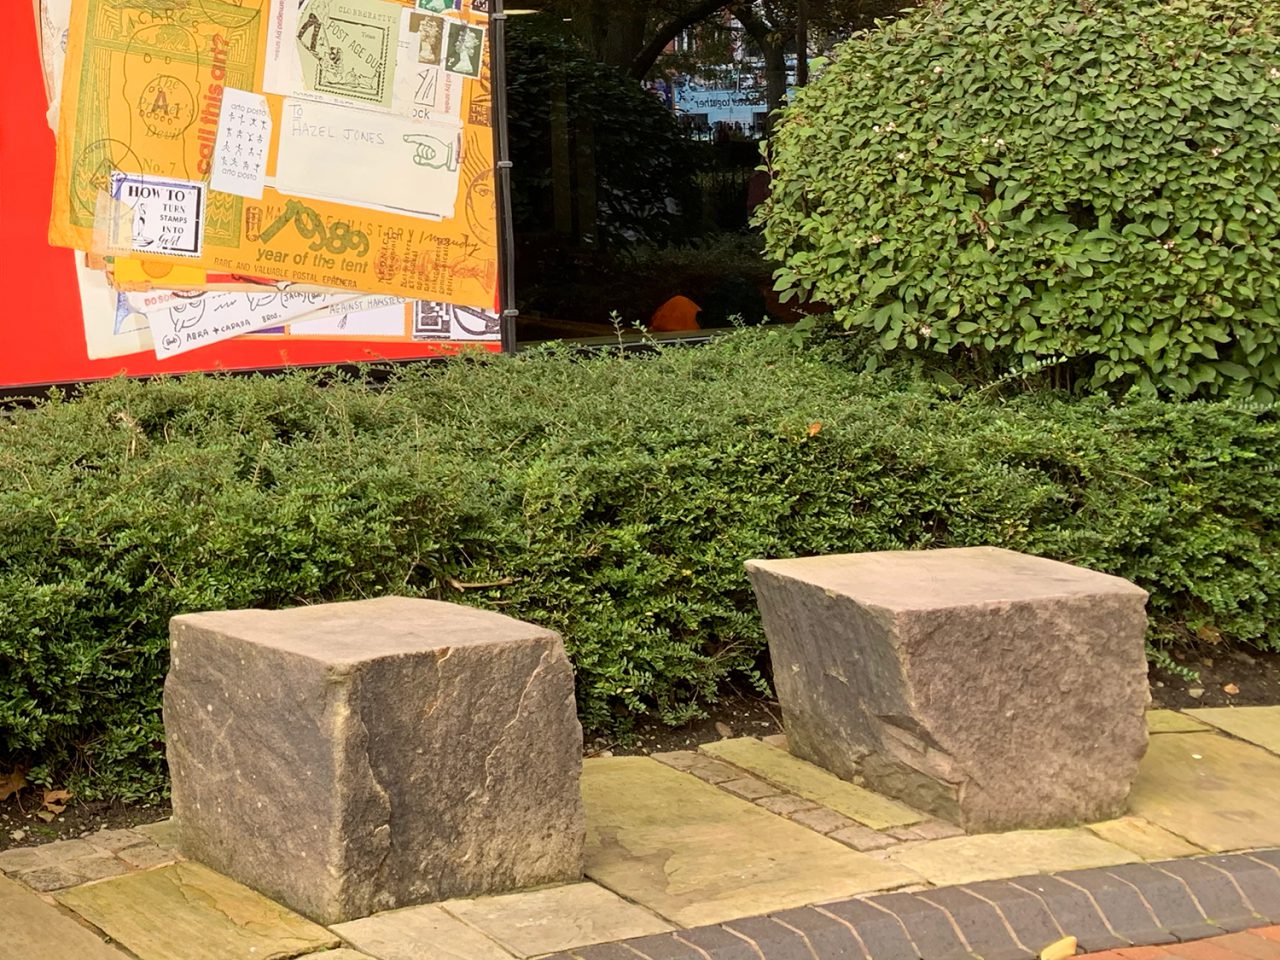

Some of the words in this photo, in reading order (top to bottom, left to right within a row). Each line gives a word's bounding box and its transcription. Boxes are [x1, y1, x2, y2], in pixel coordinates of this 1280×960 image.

[327, 20, 350, 43] POST
[349, 40, 367, 59] AGE
[200, 84, 224, 126] this
[292, 123, 335, 138] HAZEL
[343, 127, 386, 145] JONES
[196, 128, 217, 175] call
[143, 158, 165, 174] No.
[170, 162, 177, 174] 7
[128, 185, 160, 200] HOW
[166, 189, 185, 202] TO
[162, 203, 185, 214] TURN
[160, 214, 188, 224] STAMPS
[260, 198, 370, 258] 1989
[162, 226, 184, 235] INTO
[214, 257, 233, 269] RARE
[236, 261, 251, 272] AND
[254, 264, 289, 278] VALUABLE
[292, 271, 318, 282] POSTAL
[256, 247, 291, 265] year
[293, 251, 309, 267] of
[313, 254, 336, 269] the
[341, 258, 369, 274] tent
[328, 301, 364, 315] AGAINST
[186, 329, 209, 343] ABRA
